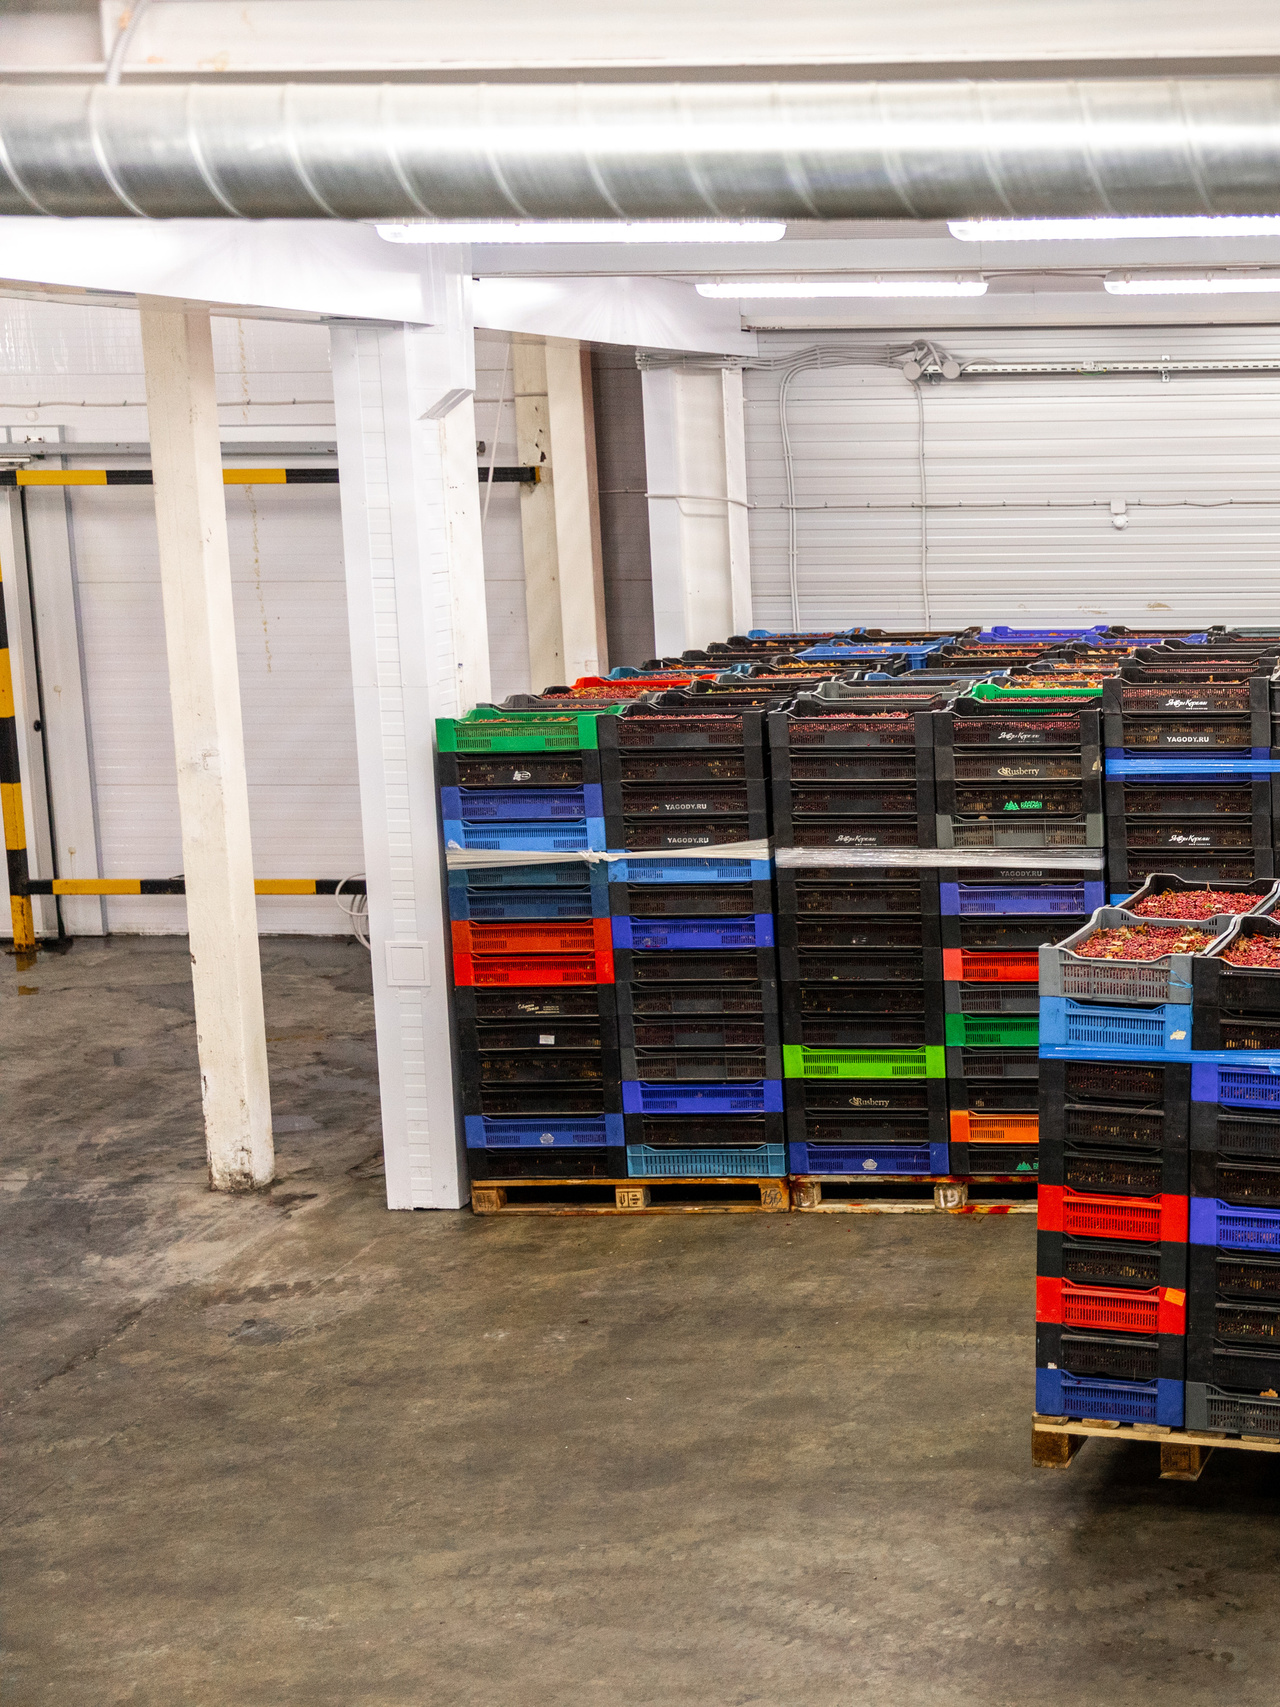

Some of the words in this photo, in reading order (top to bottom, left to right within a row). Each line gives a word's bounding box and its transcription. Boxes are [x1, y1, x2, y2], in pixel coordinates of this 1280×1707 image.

[1005, 766, 1040, 777] Rusberry
[665, 803, 707, 811] YAGODY.RU
[856, 1096, 890, 1108] Rusberry
